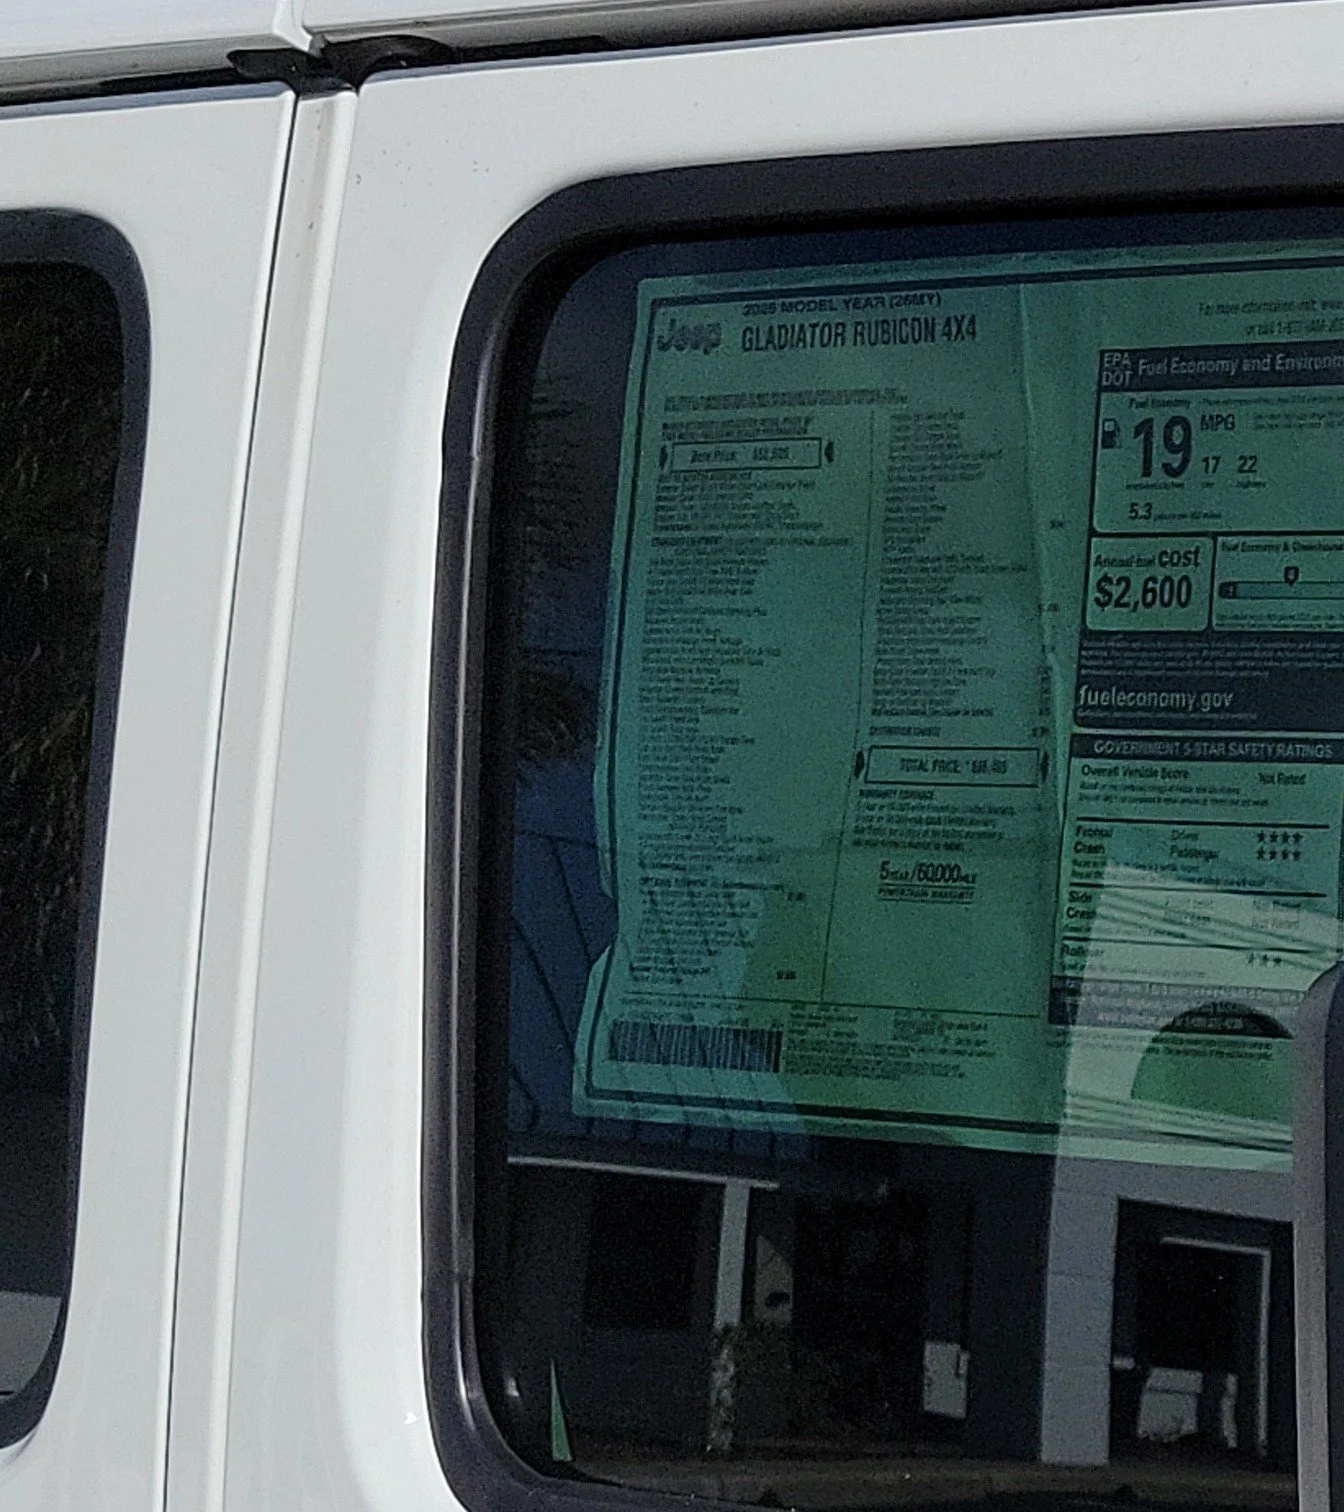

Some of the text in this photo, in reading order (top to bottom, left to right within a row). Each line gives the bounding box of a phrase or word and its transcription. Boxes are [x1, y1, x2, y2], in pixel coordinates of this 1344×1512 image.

[780, 298, 838, 313] MODEL
[842, 296, 886, 311] YEAR
[657, 318, 722, 355] Jeep
[741, 314, 978, 352] GLADIATOR RUBICON 4X4
[1103, 352, 1132, 368] EPA
[1137, 357, 1167, 376] Fuel
[1170, 355, 1239, 376] Economy
[1241, 354, 1271, 372] and
[1101, 370, 1133, 387] DOT
[1199, 413, 1236, 432] MPG
[1132, 414, 1193, 478] 19
[1201, 454, 1258, 475] 17 22
[1128, 502, 1154, 521] 5.3
[1157, 545, 1201, 568] cost
[1093, 573, 1193, 612] $2,600
[1077, 683, 1234, 711] fueleconomy.gov
[1093, 739, 1334, 759] GOVERNMENT 5-STAR SAFETY RATINGS
[1068, 890, 1093, 903] Side
